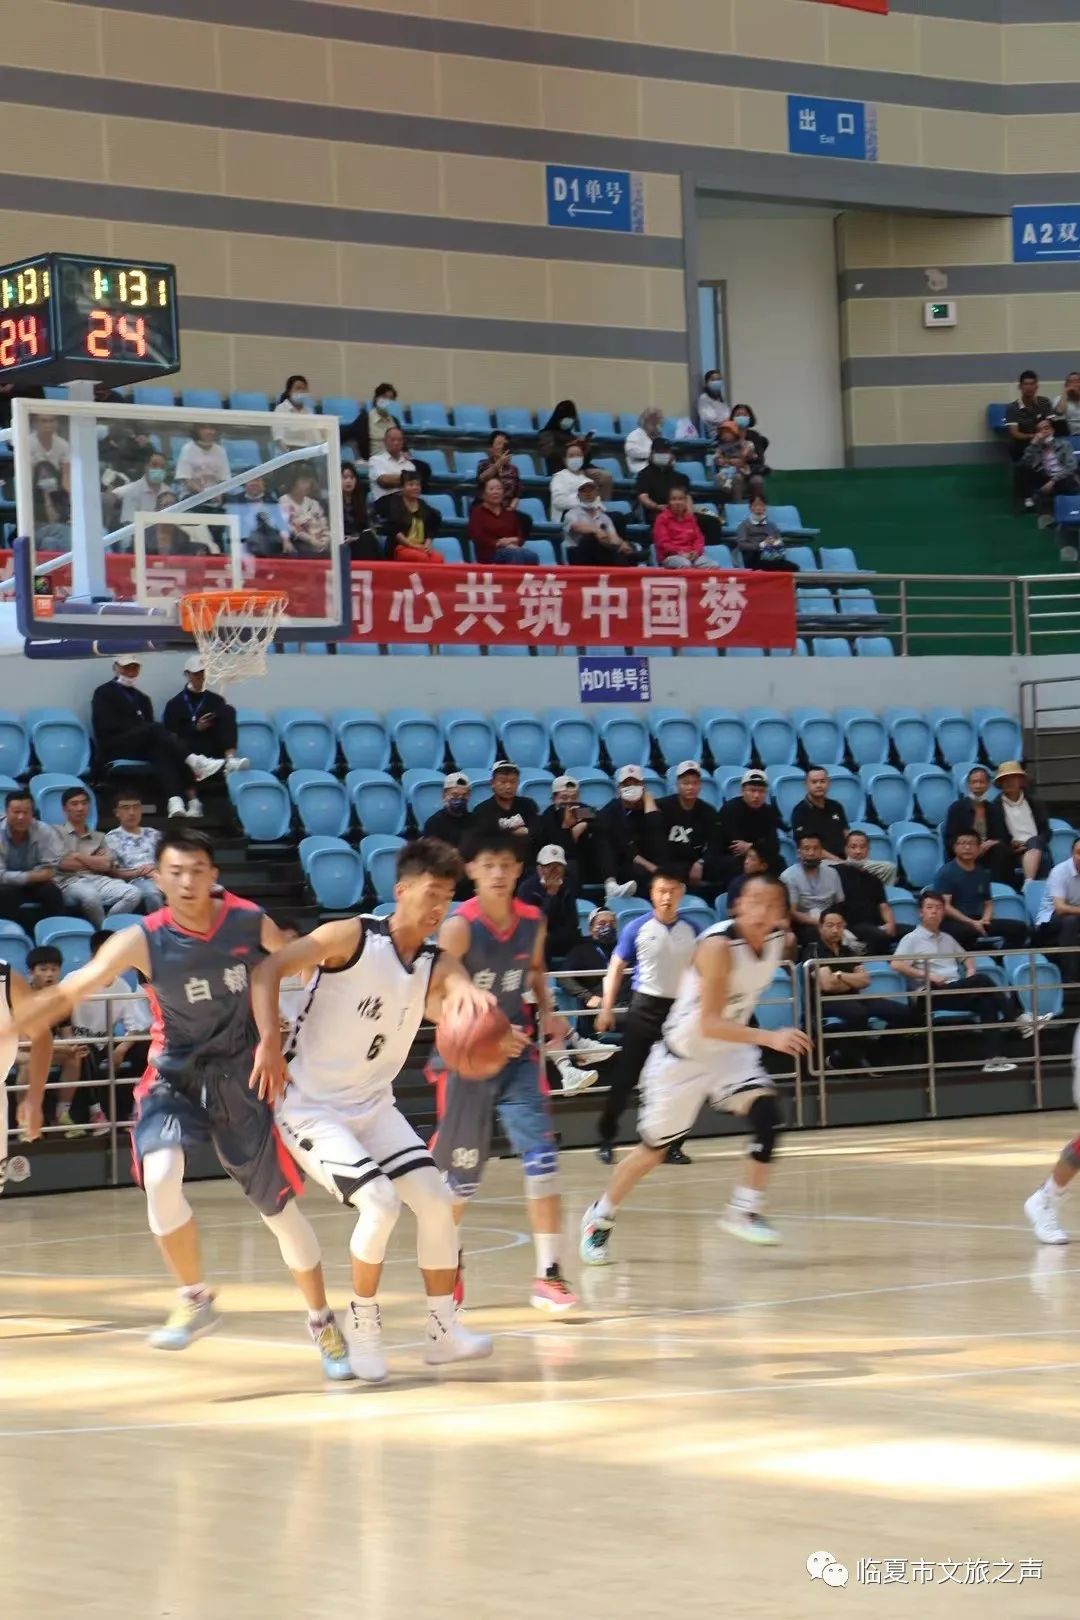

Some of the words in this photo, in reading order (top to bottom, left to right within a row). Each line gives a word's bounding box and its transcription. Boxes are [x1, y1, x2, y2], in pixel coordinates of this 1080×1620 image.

[798, 108, 855, 134] 出口
[0, 315, 38, 367] 24
[86, 310, 146, 358] 24
[580, 667, 639, 691] 内D1单号
